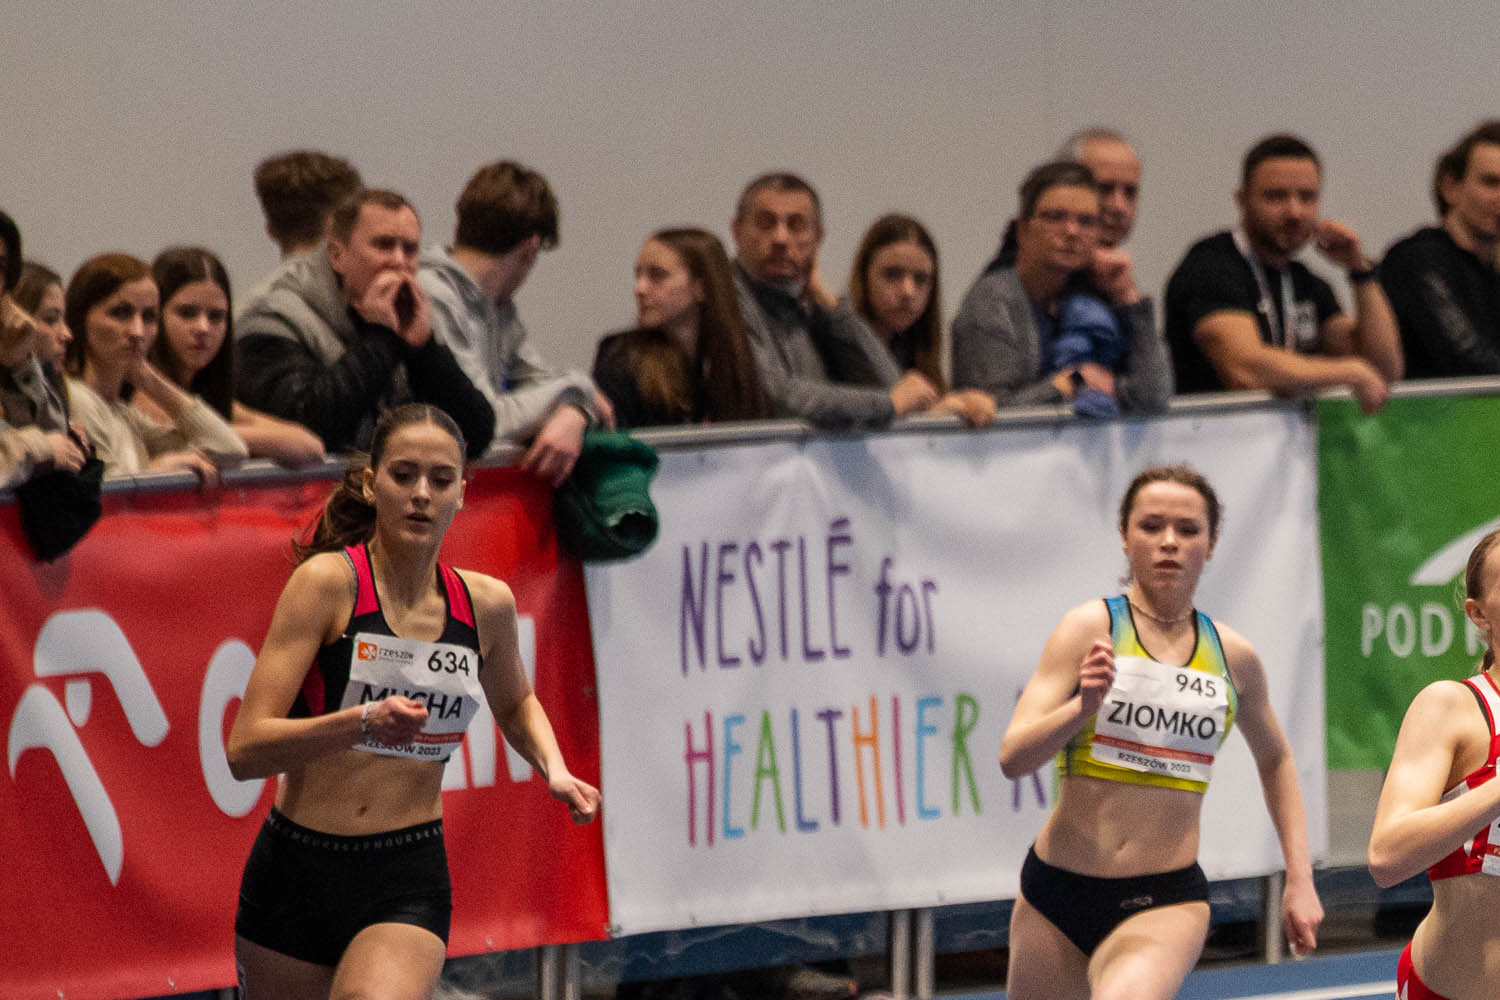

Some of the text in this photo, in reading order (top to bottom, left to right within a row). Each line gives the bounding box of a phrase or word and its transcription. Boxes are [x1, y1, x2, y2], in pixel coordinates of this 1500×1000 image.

[681, 517, 937, 677] NESTLÉ for
[428, 650, 470, 677] 634
[1176, 673, 1217, 698] 945
[1107, 699, 1216, 740] ZIOMKO
[685, 694, 981, 847] HEALTHIER
